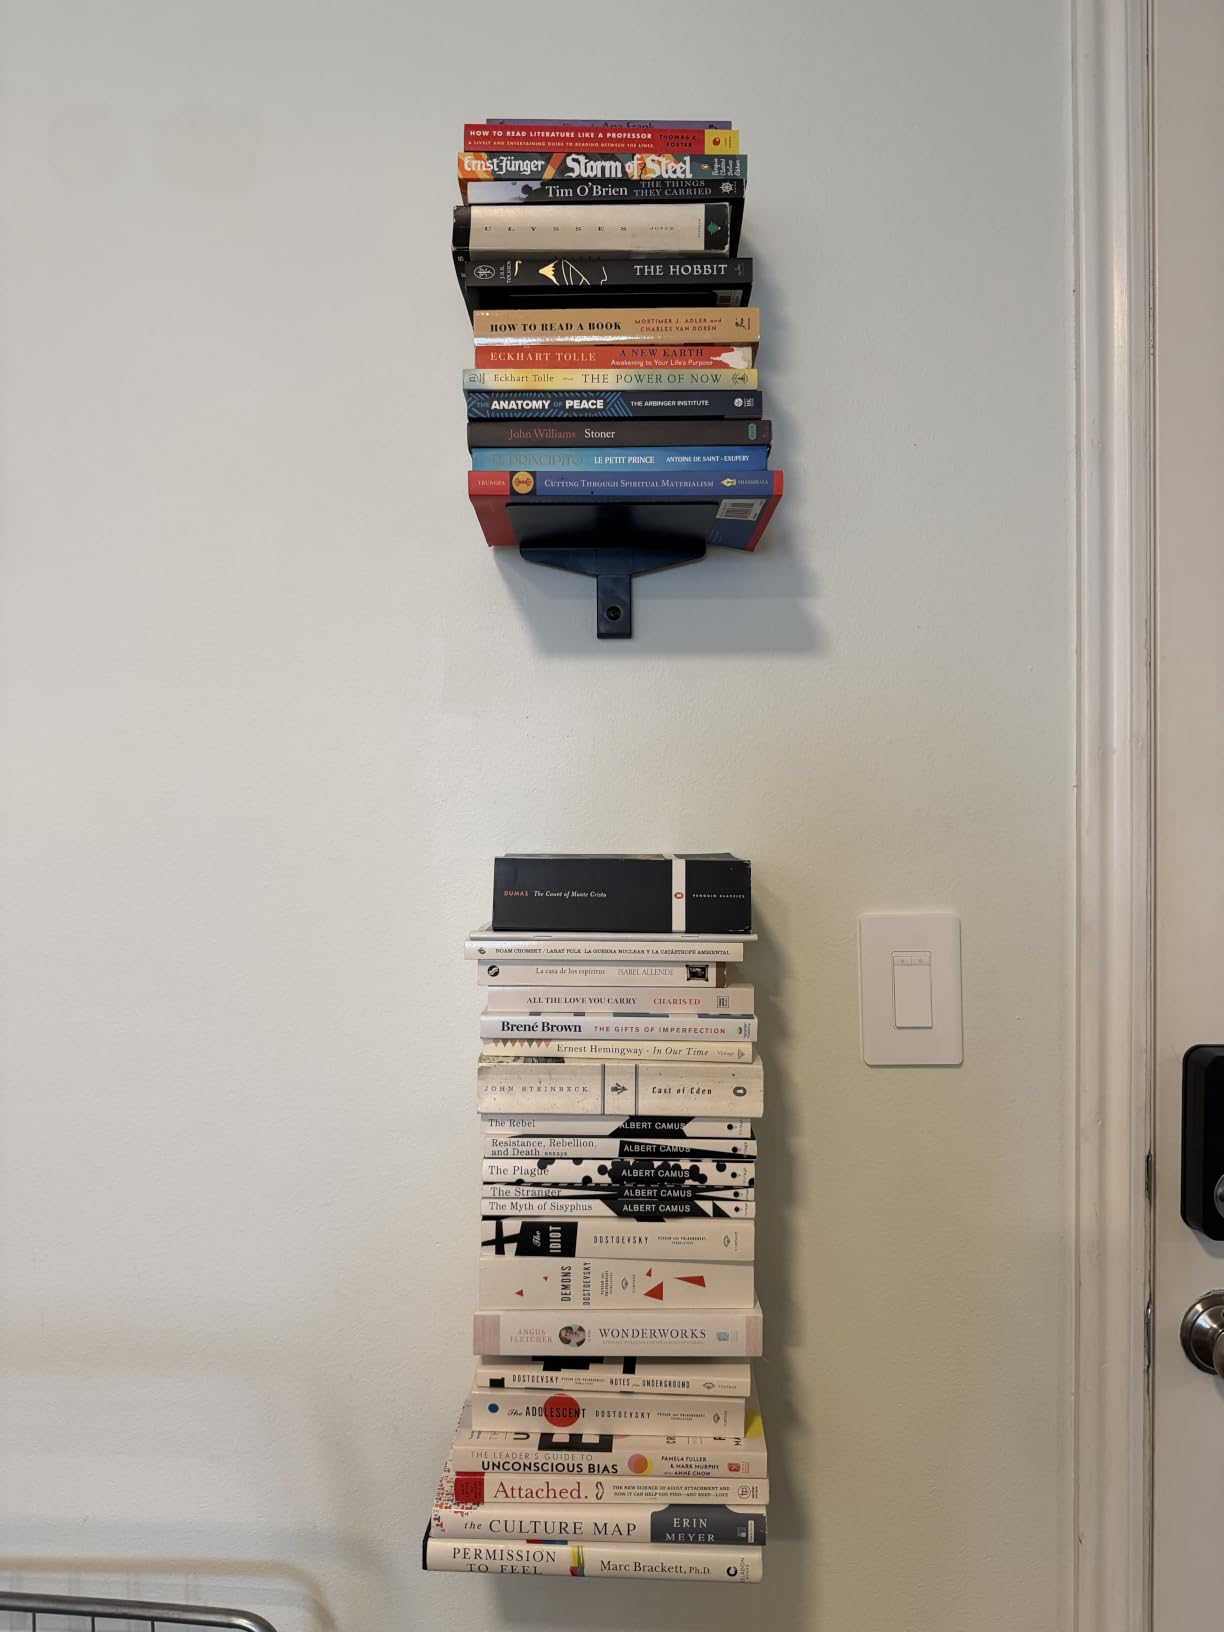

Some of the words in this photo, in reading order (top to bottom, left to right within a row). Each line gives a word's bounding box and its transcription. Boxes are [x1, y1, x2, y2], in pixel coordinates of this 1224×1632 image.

[565, 153, 623, 178] Storm
[625, 154, 644, 180] of
[645, 154, 692, 178] Steel
[640, 180, 662, 188] THE
[546, 185, 573, 197] Tim
[577, 183, 628, 197] O'Brien
[633, 189, 659, 197] THEY
[665, 188, 712, 196] CARRIED
[634, 265, 664, 275] THE
[670, 264, 728, 275] HOBBIT
[490, 324, 518, 332] HOW
[521, 323, 537, 332] TO
[541, 323, 573, 331] READ
[577, 323, 584, 331] A
[588, 322, 622, 331] BOOK
[490, 352, 551, 361] ECKHART
[556, 352, 596, 361] TOLLE
[494, 373, 528, 382] Eckhart
[532, 373, 554, 382] Tolle
[581, 374, 609, 383] THE
[616, 374, 662, 383] POWER
[667, 374, 684, 383] OF
[690, 374, 722, 383] NOW
[491, 400, 551, 409] ANATOMY
[566, 400, 604, 409] PEACE
[508, 429, 532, 440] John
[533, 428, 576, 438] Williams
[584, 428, 616, 439] Stoner
[544, 479, 579, 488] CUTTING
[580, 479, 618, 488] THROUGH
[620, 479, 659, 487] SPIRITUAL
[661, 479, 714, 487] MATERIALISM
[579, 968, 606, 977] espíritus
[501, 1020, 539, 1032] Brené
[541, 1022, 582, 1032] Brown
[557, 1044, 586, 1053] Ernest
[590, 1044, 643, 1057] Hemingway
[652, 1046, 662, 1055] In
[665, 1046, 682, 1055] Our
[686, 1047, 709, 1056] Time
[488, 1119, 506, 1127] The
[509, 1119, 536, 1127] Rebel
[655, 1122, 687, 1130] CAMUS
[491, 1139, 546, 1149] Resistance,
[549, 1139, 597, 1149] Rebellion,
[488, 1166, 511, 1175] The
[512, 1165, 550, 1177] Plague
[621, 1169, 655, 1177] ALBERT
[657, 1169, 690, 1178] CAMUS
[490, 1187, 510, 1196] The
[512, 1187, 562, 1198] Stranger
[623, 1189, 658, 1197] ALBERT
[660, 1189, 692, 1198] CAMUS
[489, 1201, 507, 1211] The
[510, 1202, 535, 1213] Myth
[537, 1201, 548, 1210] of
[550, 1202, 593, 1213] Sisyphus
[622, 1204, 657, 1213] ALBERT
[658, 1205, 691, 1213] CAMUS
[549, 1225, 561, 1253] IDIOT
[594, 1236, 649, 1245] DOSTOEVSKY
[560, 1265, 572, 1302] DEMONS
[582, 1261, 591, 1306] DOSTOEVSKY
[598, 1328, 706, 1339] WONDERWORKS
[512, 1374, 559, 1384] DOSTOEVSKY
[610, 1378, 630, 1387] NOTES
[641, 1379, 690, 1389] UNDERGROUND
[507, 1408, 523, 1416] The
[525, 1406, 586, 1419] ADOLESCENT
[595, 1410, 651, 1420] DOSTOEVSKY
[471, 1451, 488, 1459] THE
[493, 1451, 539, 1460] LEADER'S
[544, 1453, 576, 1461] GUIDE
[481, 1461, 583, 1473] UNCONSCIOUS
[588, 1463, 618, 1475] BIAS
[494, 1481, 588, 1501] Attached.
[464, 1521, 482, 1531] the
[489, 1519, 584, 1536] CULTURE
[593, 1522, 637, 1537] MAP
[673, 1517, 708, 1529] ERIN
[665, 1533, 716, 1542] MEYER
[453, 1547, 557, 1563] PERMISSION
[466, 1563, 489, 1573] TO
[500, 1564, 543, 1575] FEEL
[600, 1560, 630, 1572] Marc
[633, 1561, 687, 1576] Brackett,
[689, 1566, 712, 1576] Ph.D.
